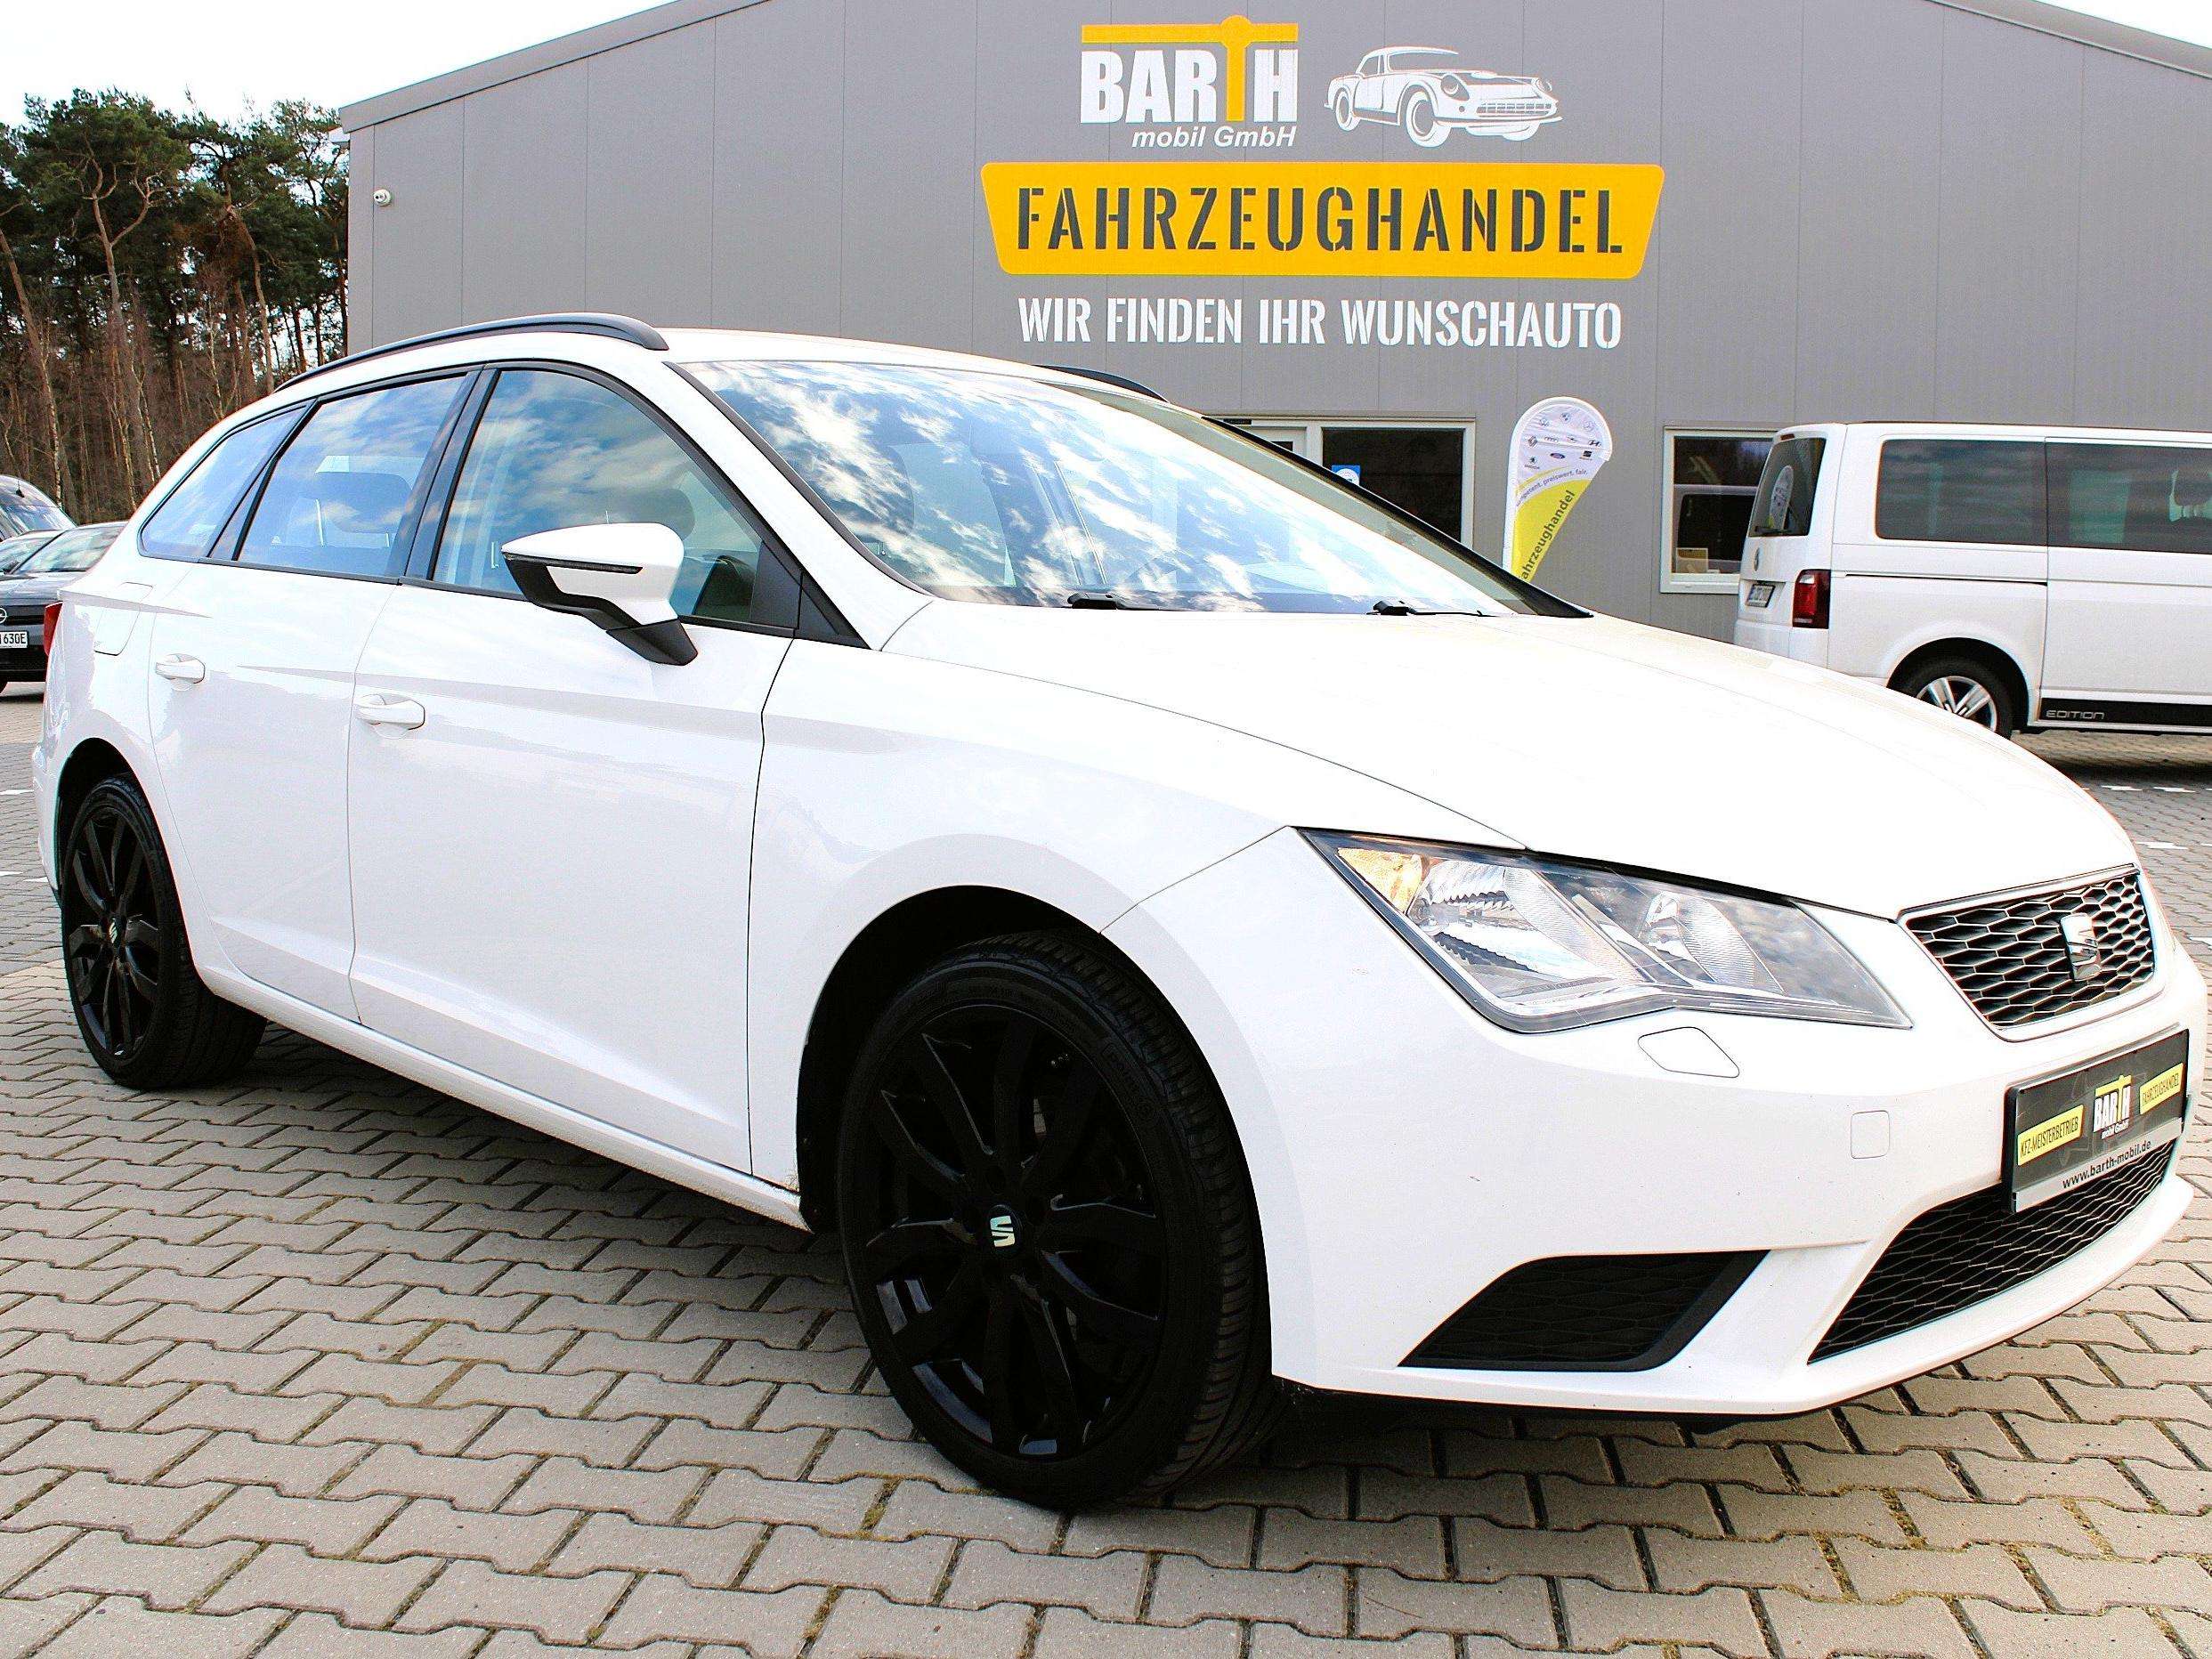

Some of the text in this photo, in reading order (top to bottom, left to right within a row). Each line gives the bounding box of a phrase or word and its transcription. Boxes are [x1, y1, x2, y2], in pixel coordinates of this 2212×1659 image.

[1080, 15, 1299, 123] BARTH
[1131, 125, 1297, 149] mobil GmbH
[1017, 187, 1623, 254] FAHRZEUGHANDEL
[1018, 297, 1623, 350] WIR FINDEN IHR WUNSCHAUTO
[1519, 490, 1576, 580] ahrzeughandel
[2046, 709, 2104, 719] EDITION
[2093, 1075, 2132, 1132] BARTH
[2062, 1140, 2151, 1188] www.barth-mobil.de
